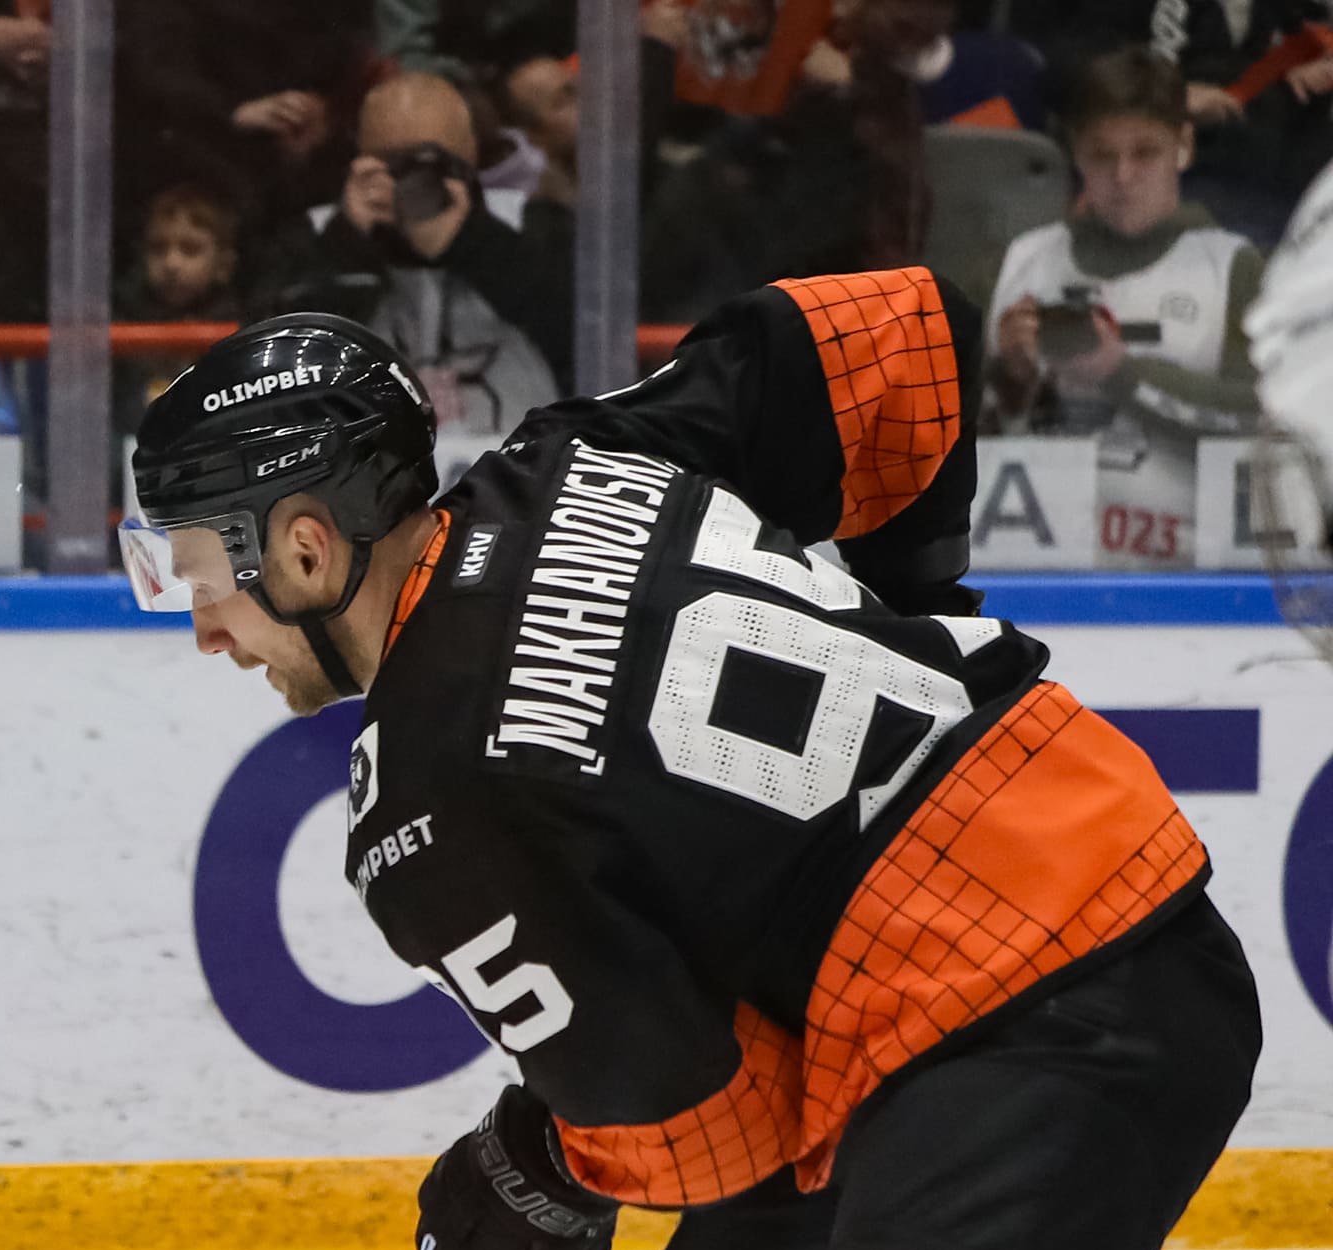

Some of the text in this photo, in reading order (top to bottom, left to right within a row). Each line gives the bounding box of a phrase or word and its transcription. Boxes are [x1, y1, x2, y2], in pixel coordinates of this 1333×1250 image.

[202, 363, 323, 414] OLIMPBET
[255, 442, 322, 478] CCM
[458, 531, 494, 579] KHV
[1099, 505, 1181, 560] 023
[646, 485, 1003, 834] 95
